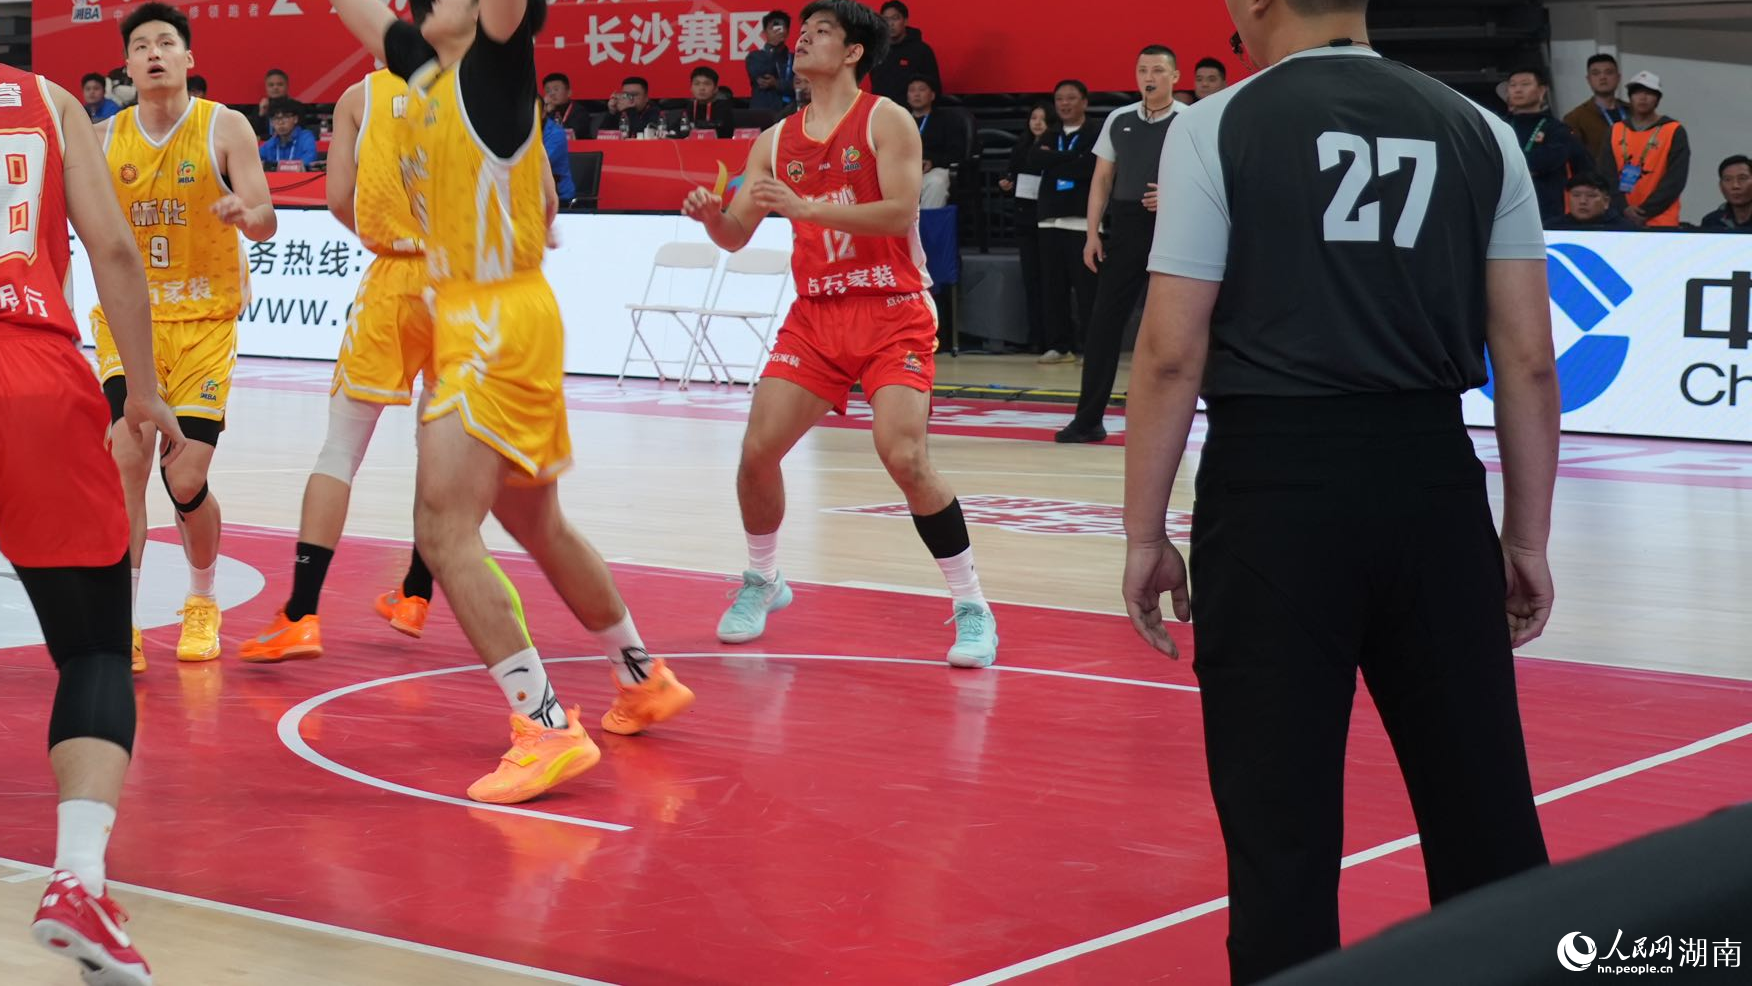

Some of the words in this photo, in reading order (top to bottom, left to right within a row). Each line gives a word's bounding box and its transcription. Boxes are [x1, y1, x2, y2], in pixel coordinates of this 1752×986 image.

[1317, 130, 1438, 249] 27
[130, 198, 187, 227] 怀化
[149, 234, 170, 269] 9
[822, 228, 856, 264] 12
